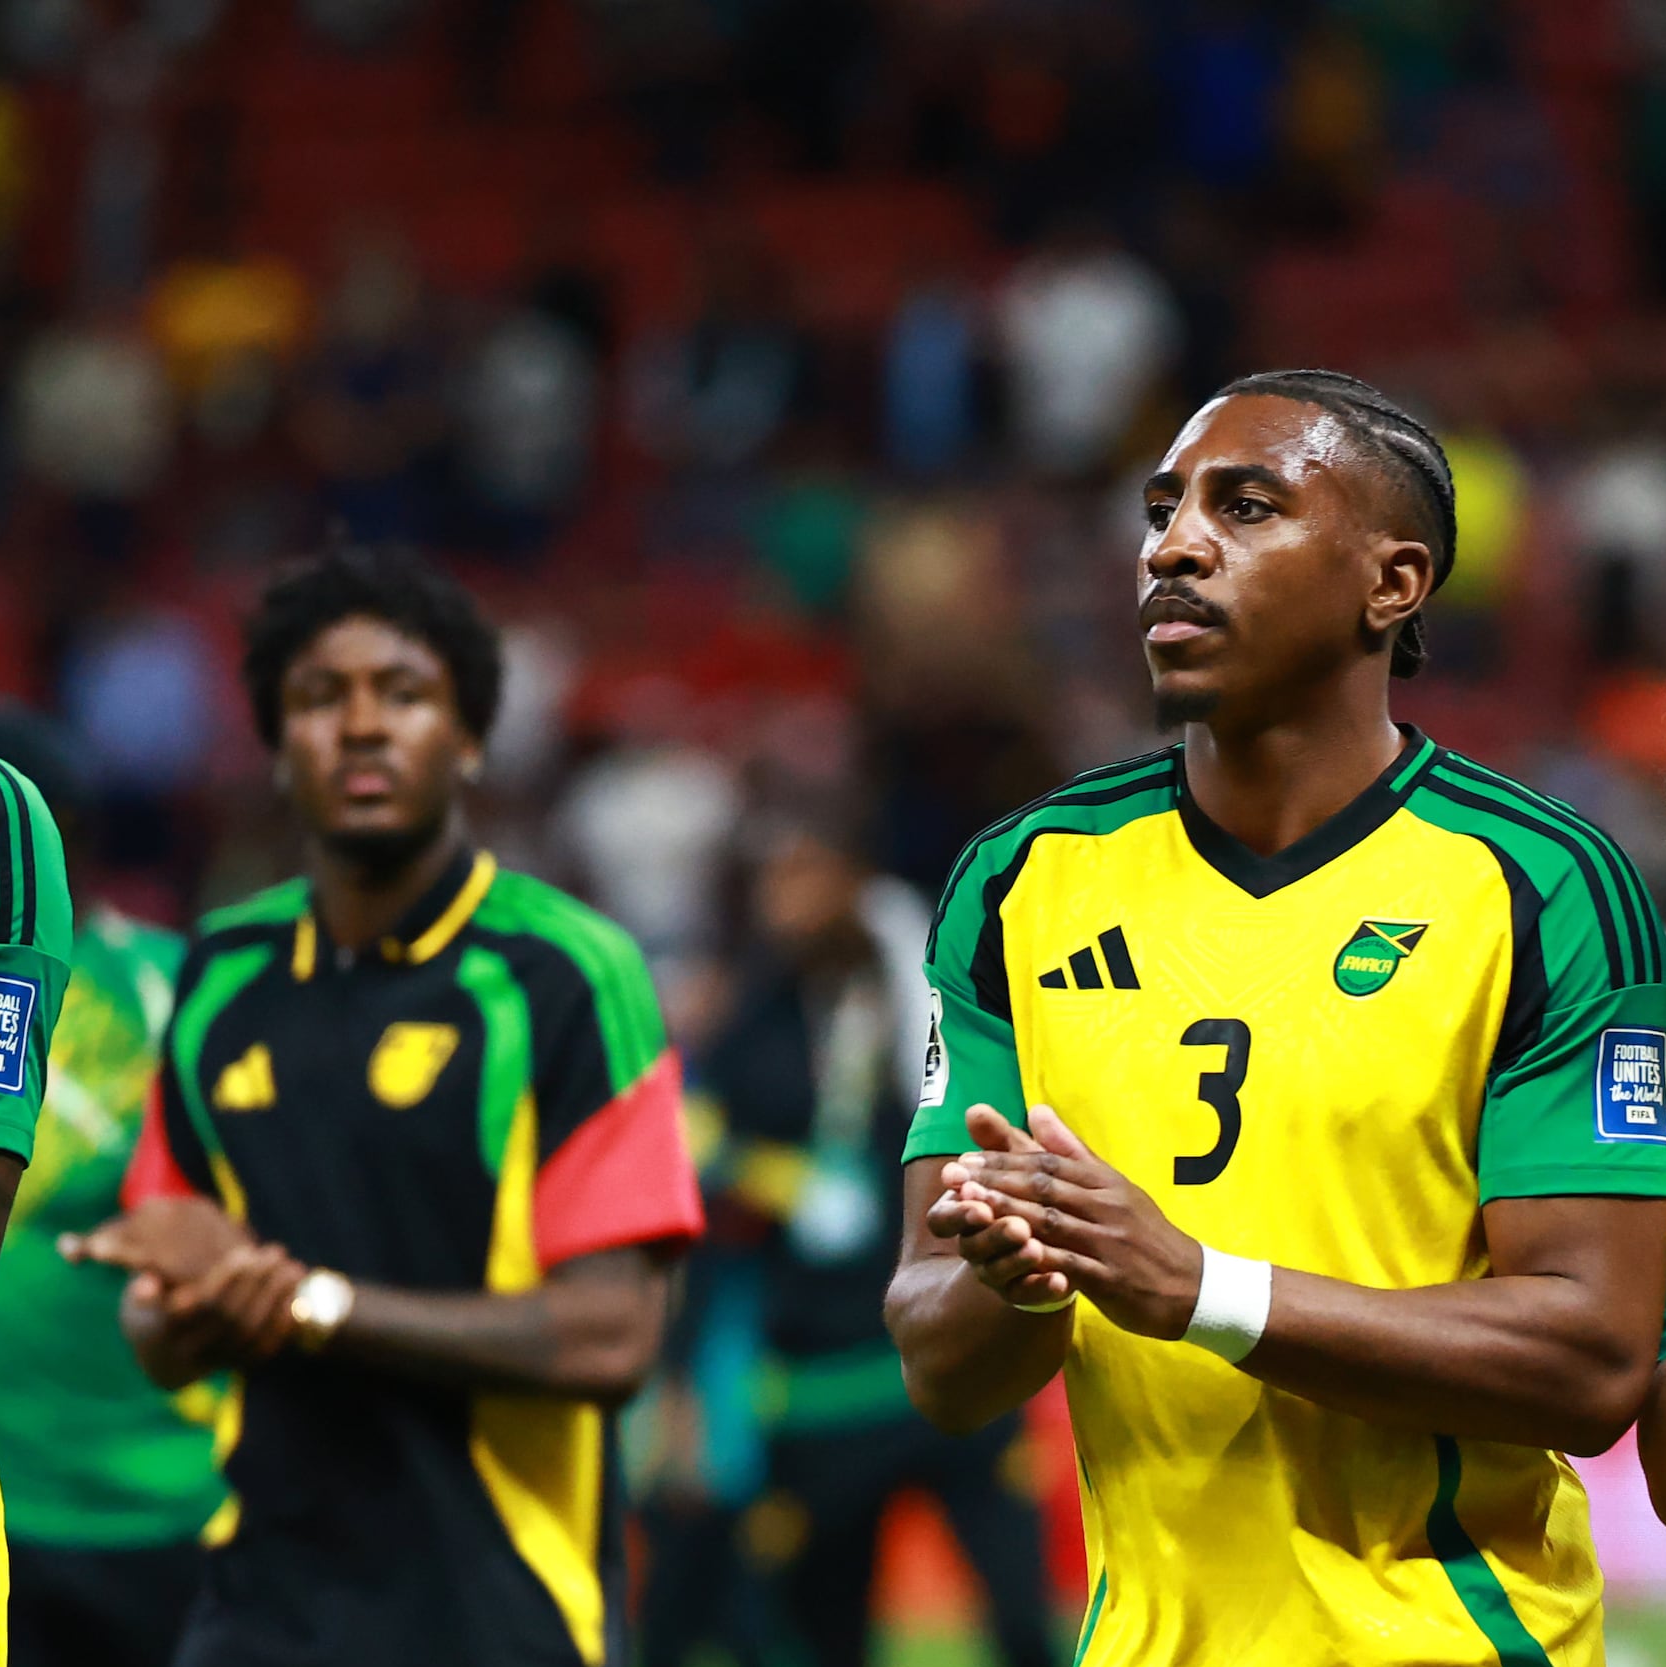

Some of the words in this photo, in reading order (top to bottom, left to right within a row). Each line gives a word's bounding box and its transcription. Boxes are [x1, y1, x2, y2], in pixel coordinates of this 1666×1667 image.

[1338, 955, 1393, 974] JAMAICA
[1614, 1044, 1660, 1062] FOOTBALL
[1613, 1061, 1661, 1084] UNITES
[1173, 1018, 1251, 1185] 3
[1609, 1083, 1632, 1102] the
[1633, 1084, 1663, 1106] World
[1631, 1110, 1651, 1119] FIFA
